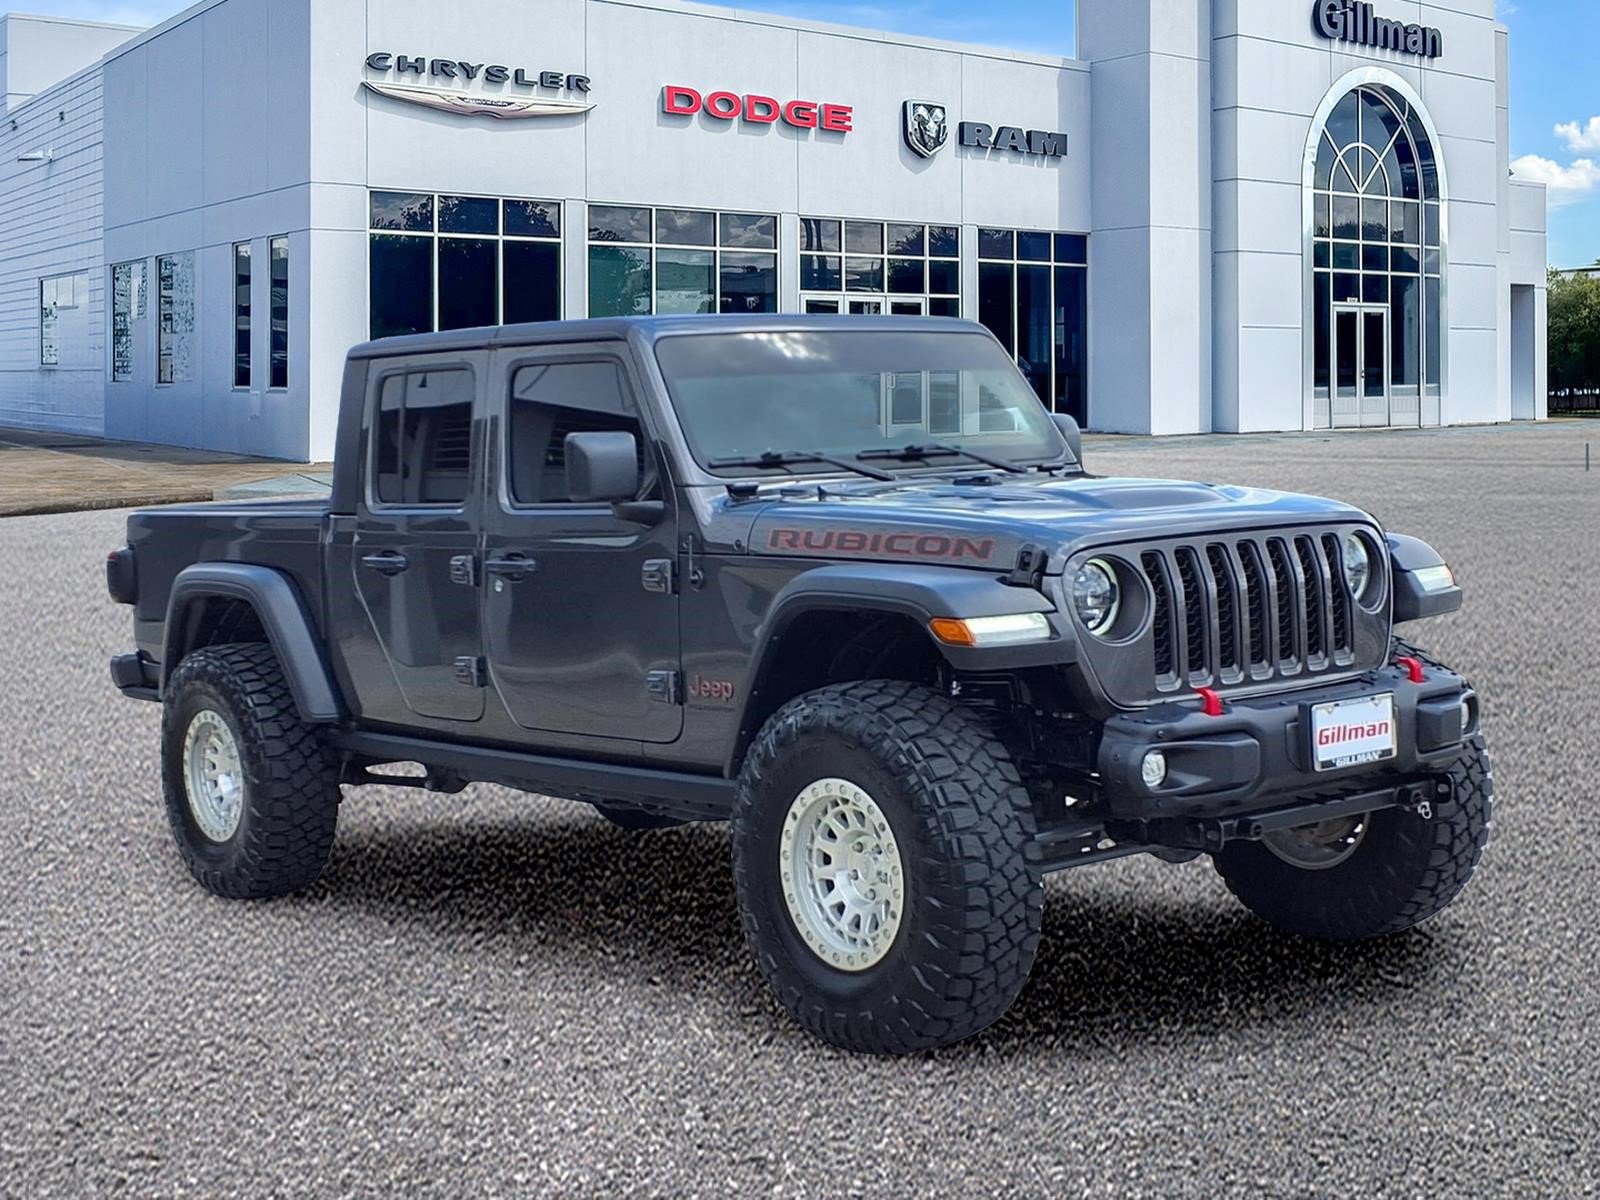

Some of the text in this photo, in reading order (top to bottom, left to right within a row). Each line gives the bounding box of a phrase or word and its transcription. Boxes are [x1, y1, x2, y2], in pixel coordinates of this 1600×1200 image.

[1313, 0, 1443, 57] Gillman
[365, 52, 592, 92] CHRYSLER
[661, 84, 852, 133] DODGE
[959, 121, 1068, 157] RAM
[768, 528, 995, 561] RUBICON
[689, 674, 734, 703] Jeep
[1318, 721, 1389, 746] Gillman
